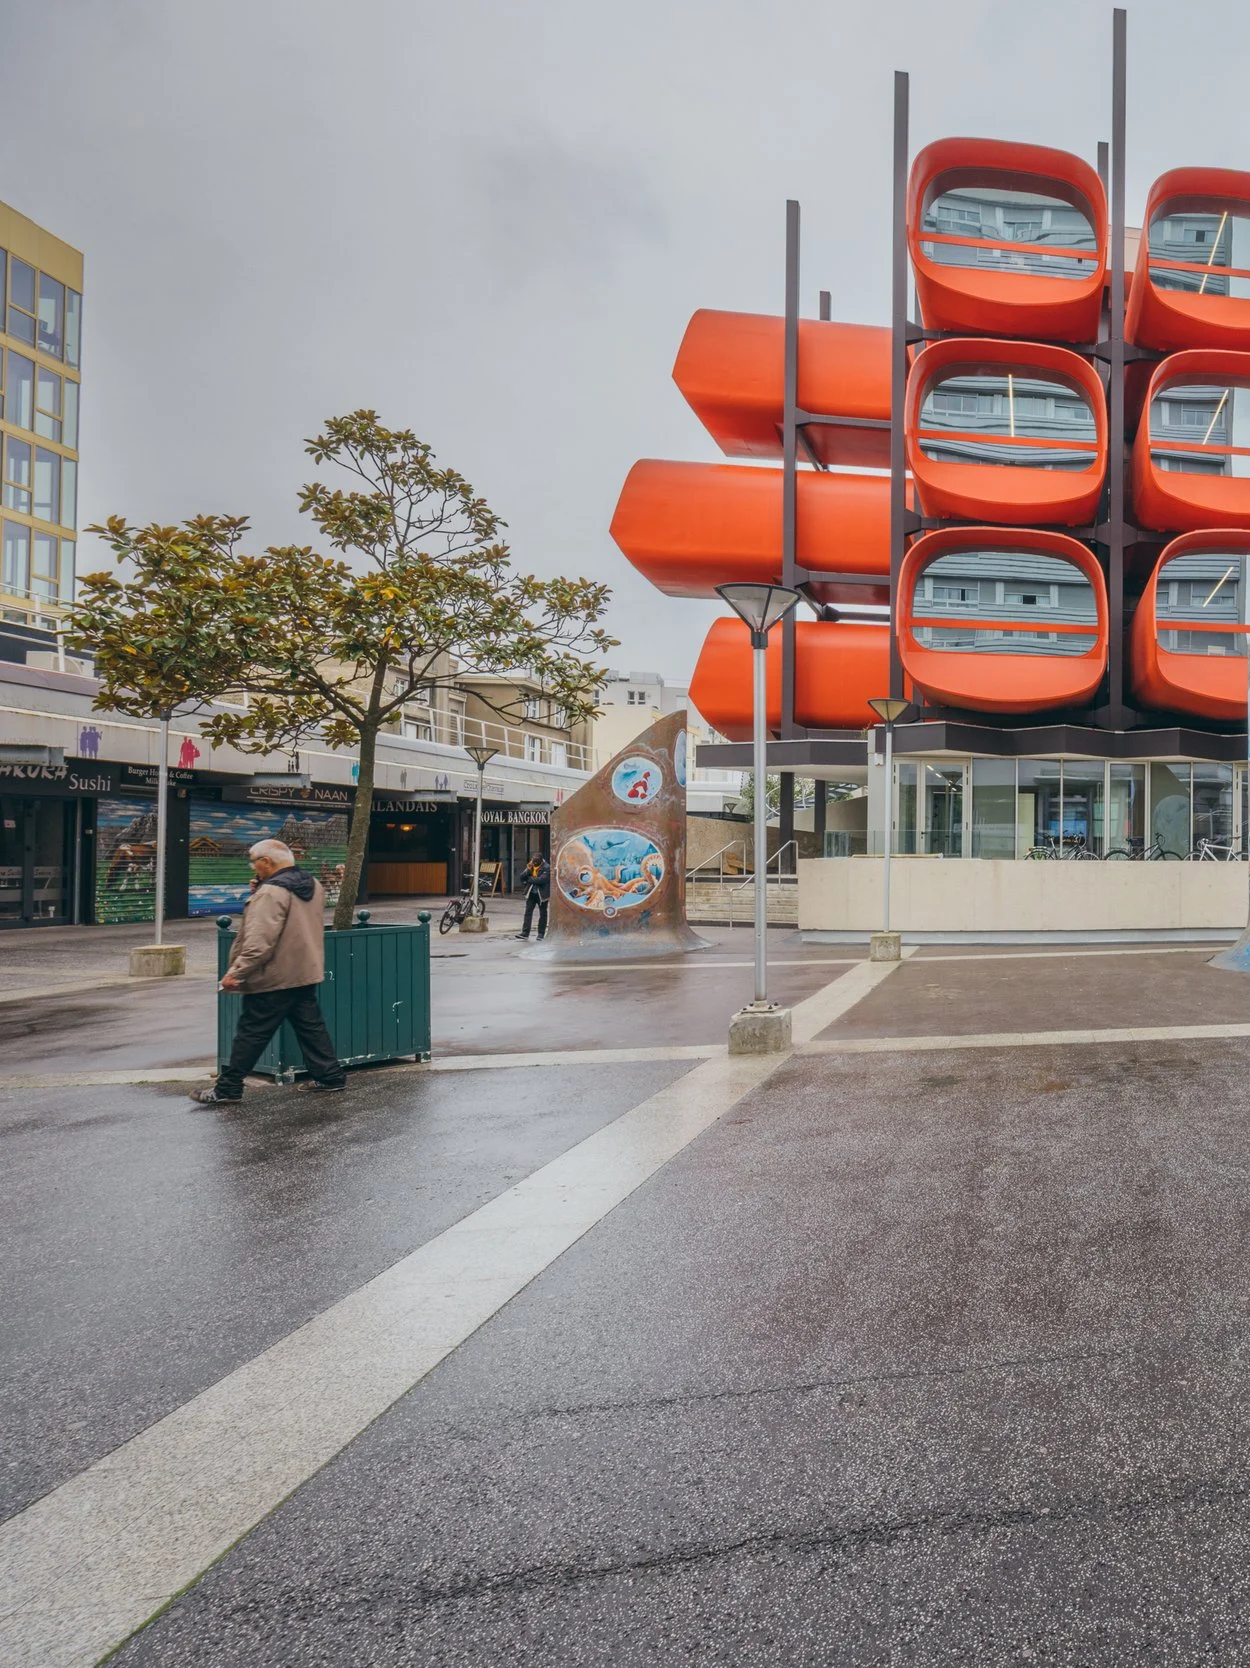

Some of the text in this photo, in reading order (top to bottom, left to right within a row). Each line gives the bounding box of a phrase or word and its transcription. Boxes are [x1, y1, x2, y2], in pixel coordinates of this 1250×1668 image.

[128, 766, 149, 777] Burger
[175, 771, 194, 780] Coffee
[68, 773, 112, 792] Sushi
[146, 777, 177, 787] Milkake
[250, 787, 348, 801] CRISPY NAAN
[372, 801, 438, 813] ILANDAIS
[508, 811, 547, 824] BANGKOK
